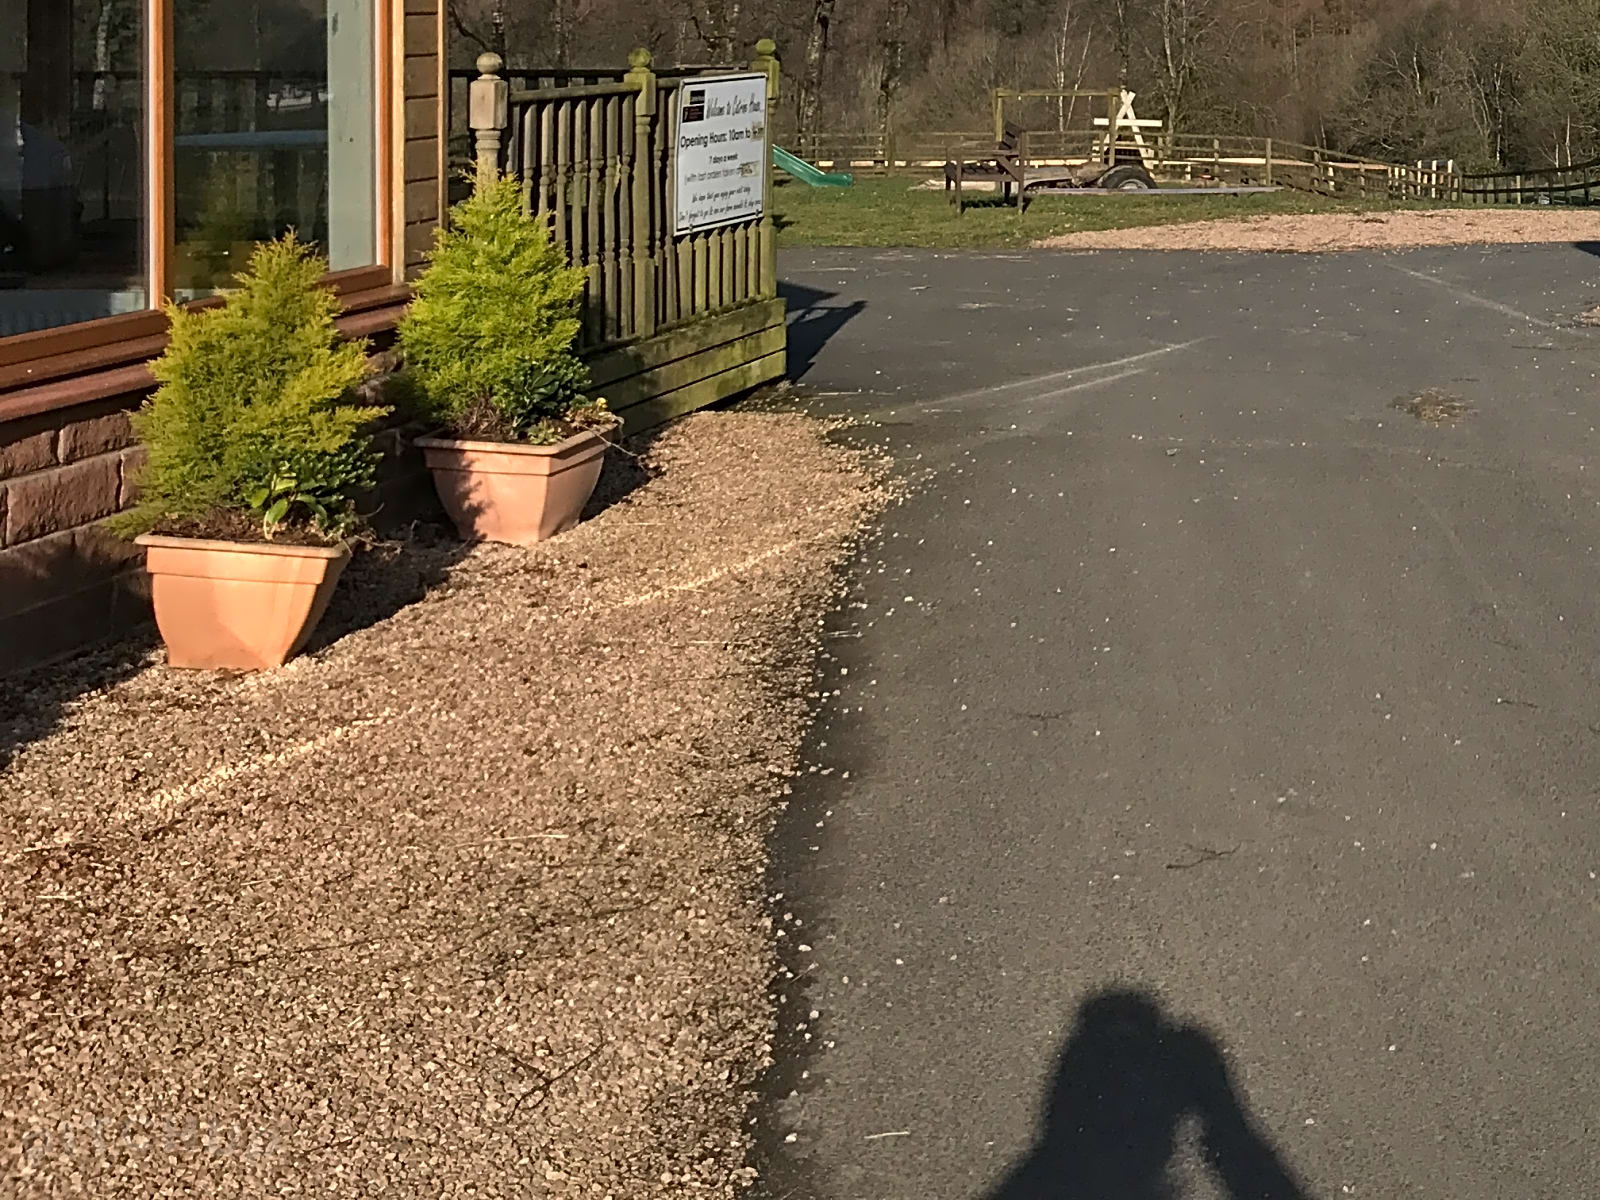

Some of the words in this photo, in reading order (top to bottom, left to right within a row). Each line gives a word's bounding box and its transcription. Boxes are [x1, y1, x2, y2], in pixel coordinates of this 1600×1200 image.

[680, 133, 708, 150] Opening
[709, 131, 727, 144] Hours:
[729, 129, 744, 141] 10am
[745, 127, 751, 139] to
